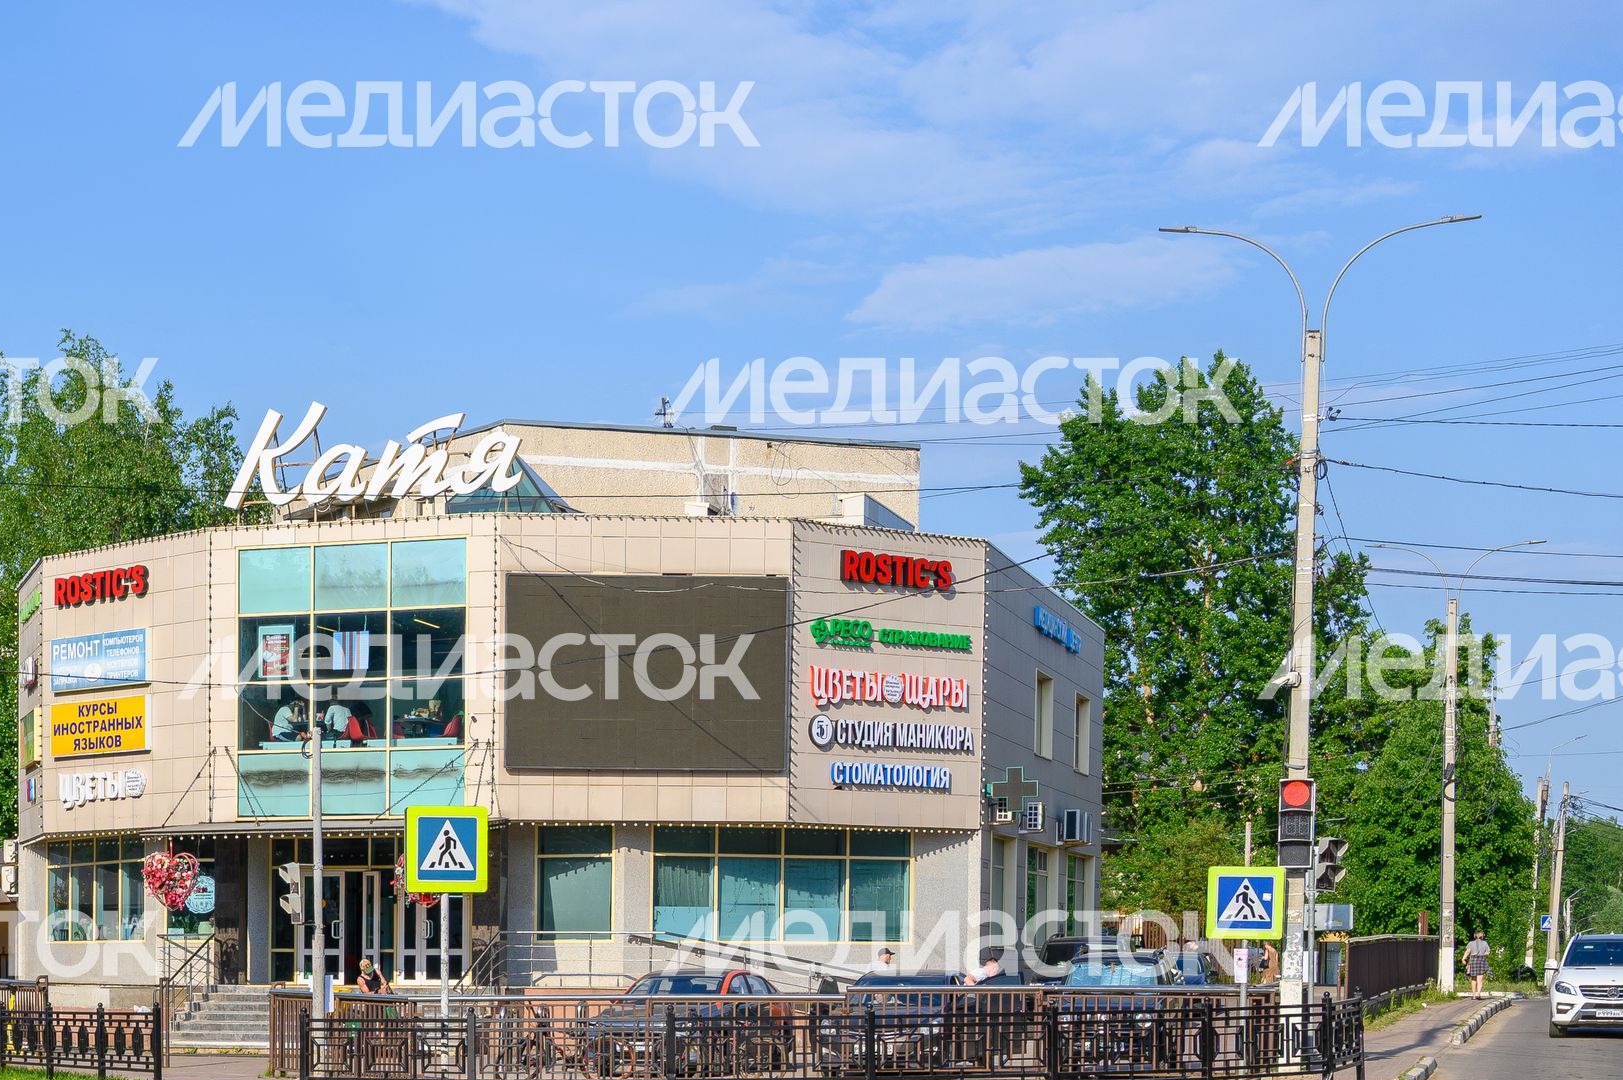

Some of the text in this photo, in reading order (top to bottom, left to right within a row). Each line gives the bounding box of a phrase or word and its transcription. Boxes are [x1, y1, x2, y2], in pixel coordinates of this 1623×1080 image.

[224, 400, 523, 510] Катя
[54, 564, 145, 606] ROSTIC'S
[842, 549, 953, 591] ROSTIC'S
[829, 618, 972, 650] РЕСО СТРАХОВАНИЕ
[52, 640, 101, 661] РЕМОНТ
[106, 646, 140, 657] ТЕЛЕФОНОВ
[810, 665, 883, 706] ЦВЕТЫ
[78, 701, 118, 718] КУРСЫ
[53, 715, 144, 737] ИНОСТРАННЫХ
[836, 718, 893, 748] СТУДИЯ
[895, 722, 974, 751] МАНИКЮРА
[73, 734, 123, 752] ЯЗЫКОВ
[58, 769, 126, 809] ЦВЕТЫ
[831, 760, 951, 789] СТОМАТОЛОГИЯ
